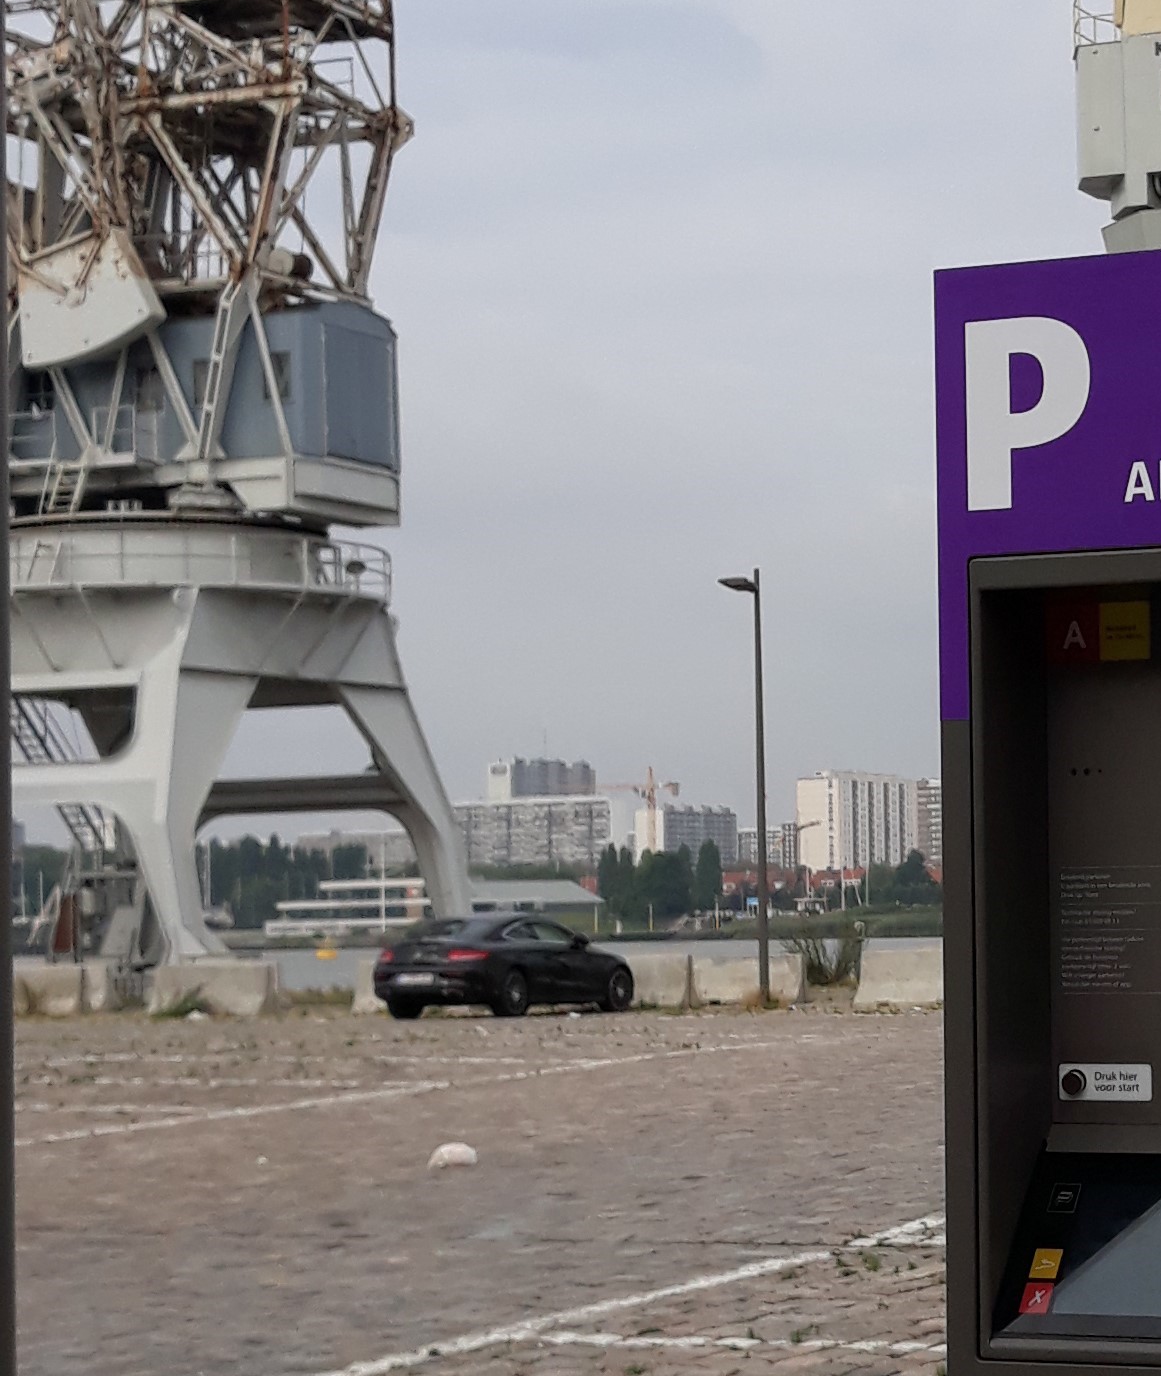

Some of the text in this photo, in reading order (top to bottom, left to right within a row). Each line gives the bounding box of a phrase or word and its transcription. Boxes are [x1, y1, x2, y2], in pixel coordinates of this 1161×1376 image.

[964, 316, 1092, 512] P
[1063, 620, 1087, 650] A
[1094, 1070, 1138, 1081] Druk hier
[1094, 1083, 1140, 1093] voor start
